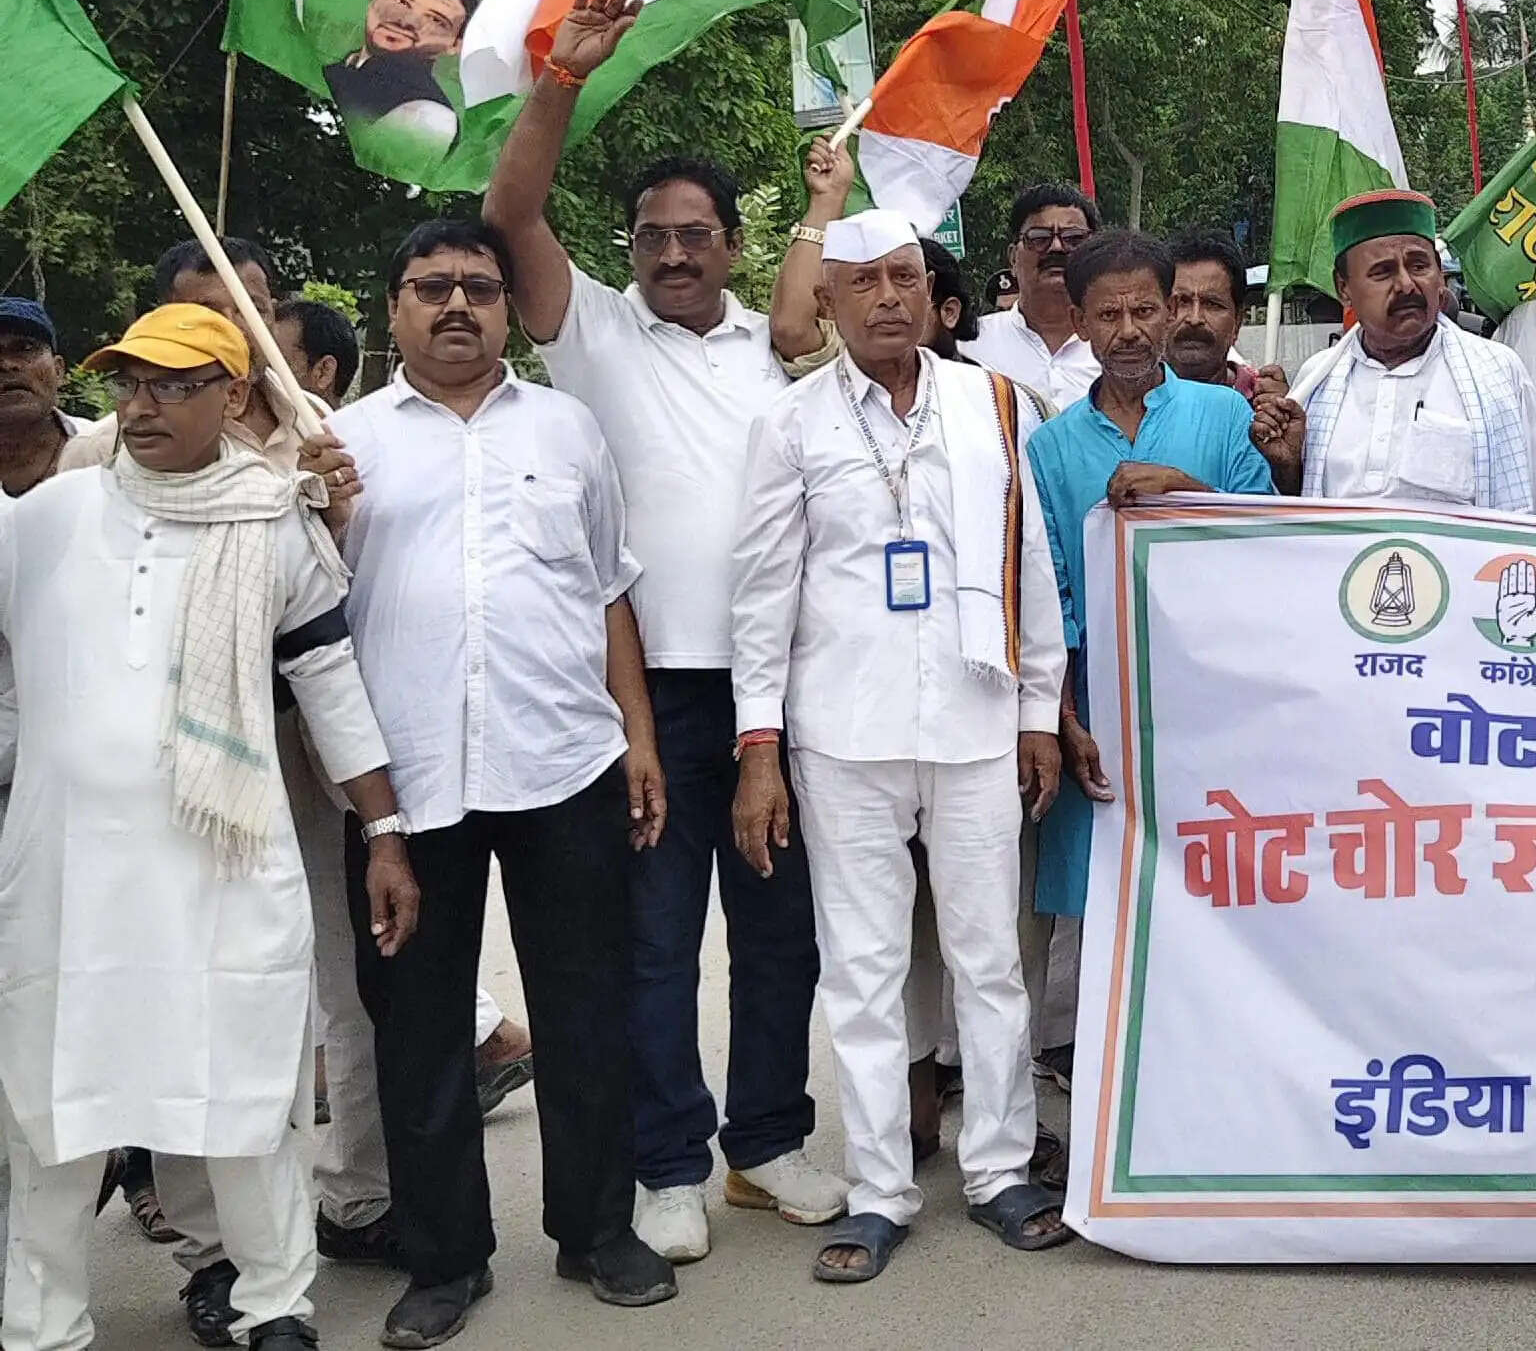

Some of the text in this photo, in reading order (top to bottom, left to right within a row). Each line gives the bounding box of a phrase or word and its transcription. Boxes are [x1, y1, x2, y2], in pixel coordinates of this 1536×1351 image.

[1354, 652, 1426, 678] राजद
[1176, 790, 1314, 908] वोट
[1326, 779, 1473, 898] चोर
[1331, 1054, 1531, 1149] इंडिया
